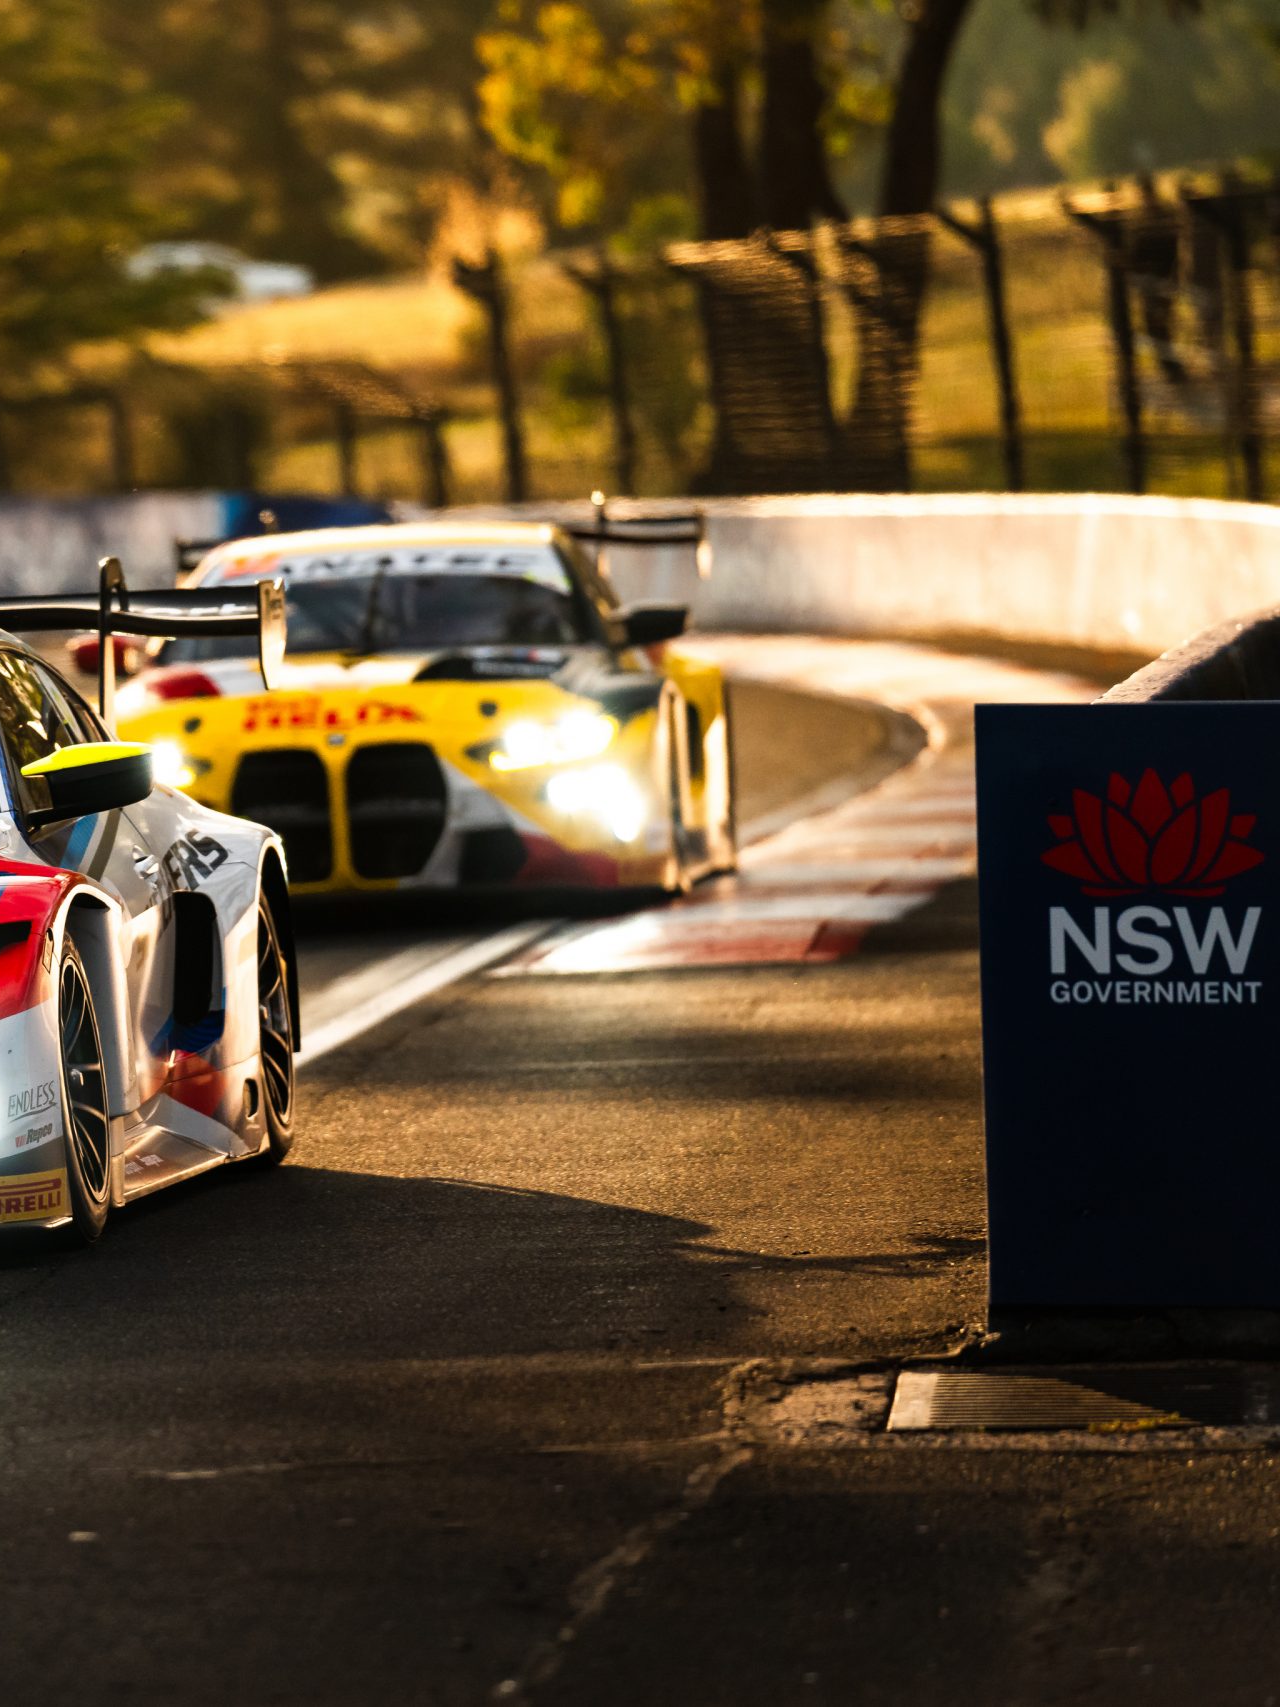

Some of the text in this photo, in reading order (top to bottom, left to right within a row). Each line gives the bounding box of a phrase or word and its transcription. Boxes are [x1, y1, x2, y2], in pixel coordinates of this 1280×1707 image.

[1049, 905, 1262, 975] NSW
[1050, 980, 1263, 1003] GOVERNMENT
[7, 1080, 56, 1119] ENDLESS
[25, 1122, 53, 1145] Repco
